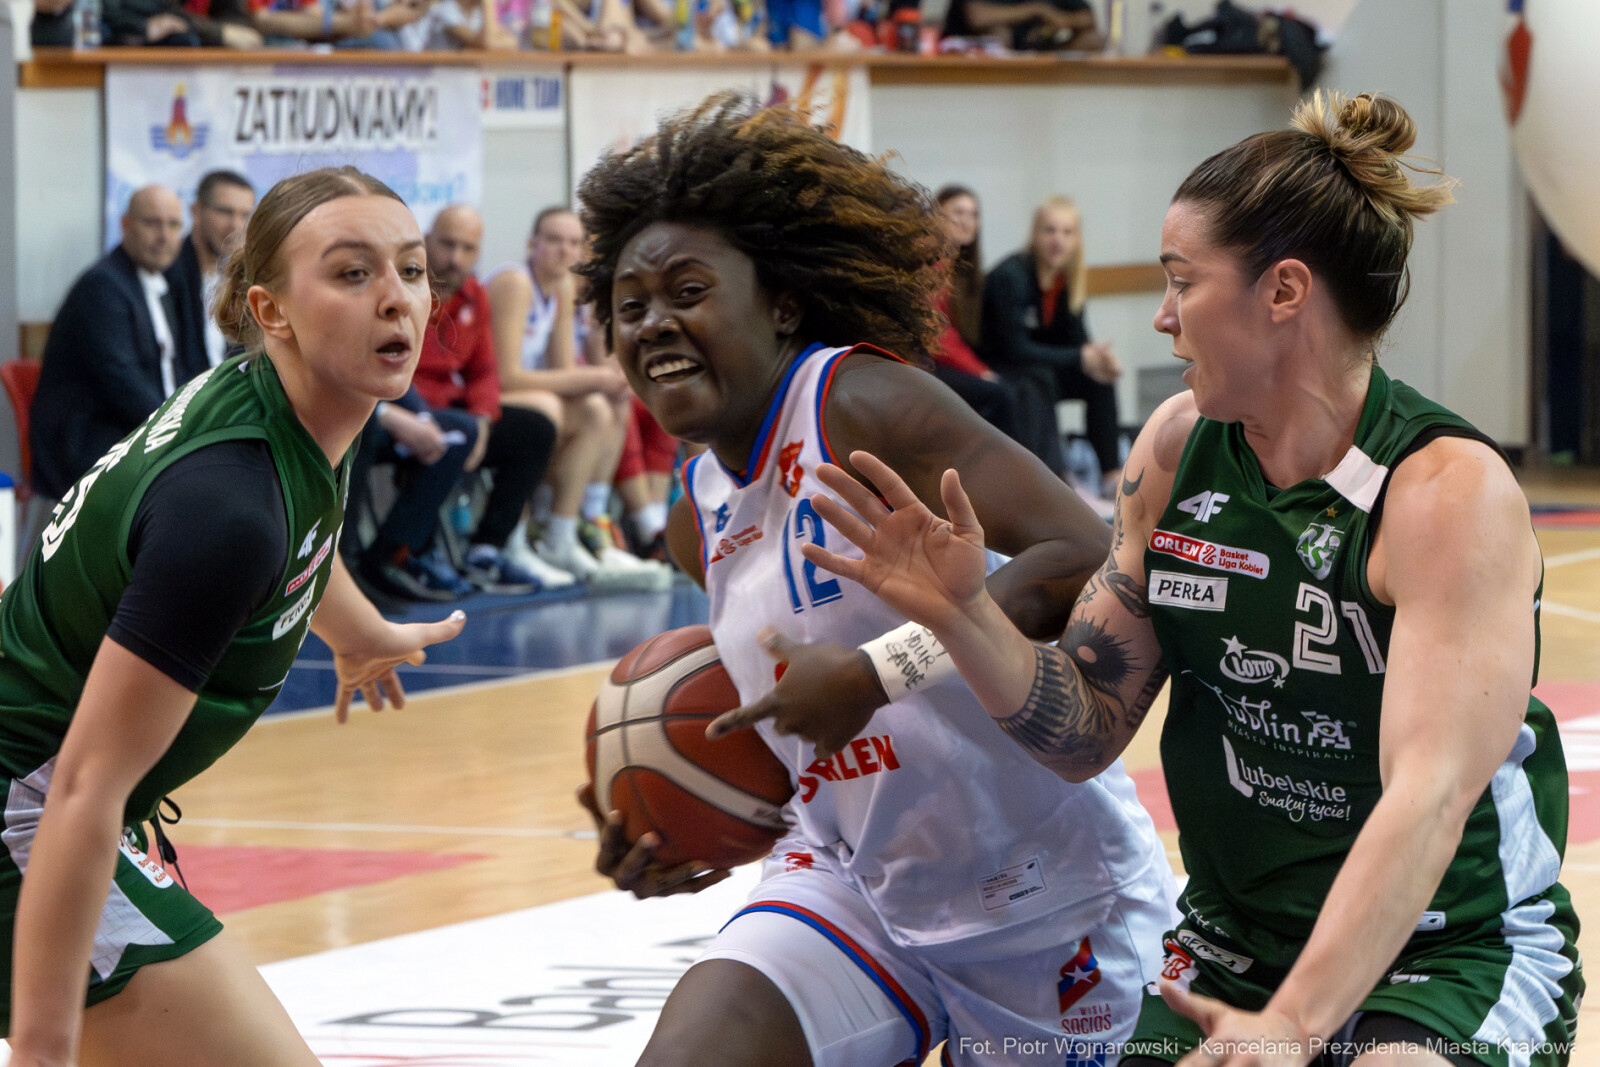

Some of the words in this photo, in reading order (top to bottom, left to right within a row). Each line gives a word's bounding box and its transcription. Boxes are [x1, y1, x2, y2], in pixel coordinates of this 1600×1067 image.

[1177, 490, 1230, 523] 4F
[783, 498, 844, 614] 12
[1153, 535, 1201, 558] ORLEN
[1219, 548, 1249, 561] Basket
[1218, 557, 1238, 573] Liga
[1238, 561, 1264, 576] Kobiet
[1156, 579, 1216, 603] PERŁA
[1292, 581, 1386, 675] 21
[904, 630, 936, 672] YOUR
[1231, 656, 1275, 678] LOTTO
[1061, 1014, 1112, 1035] SOCIOS
